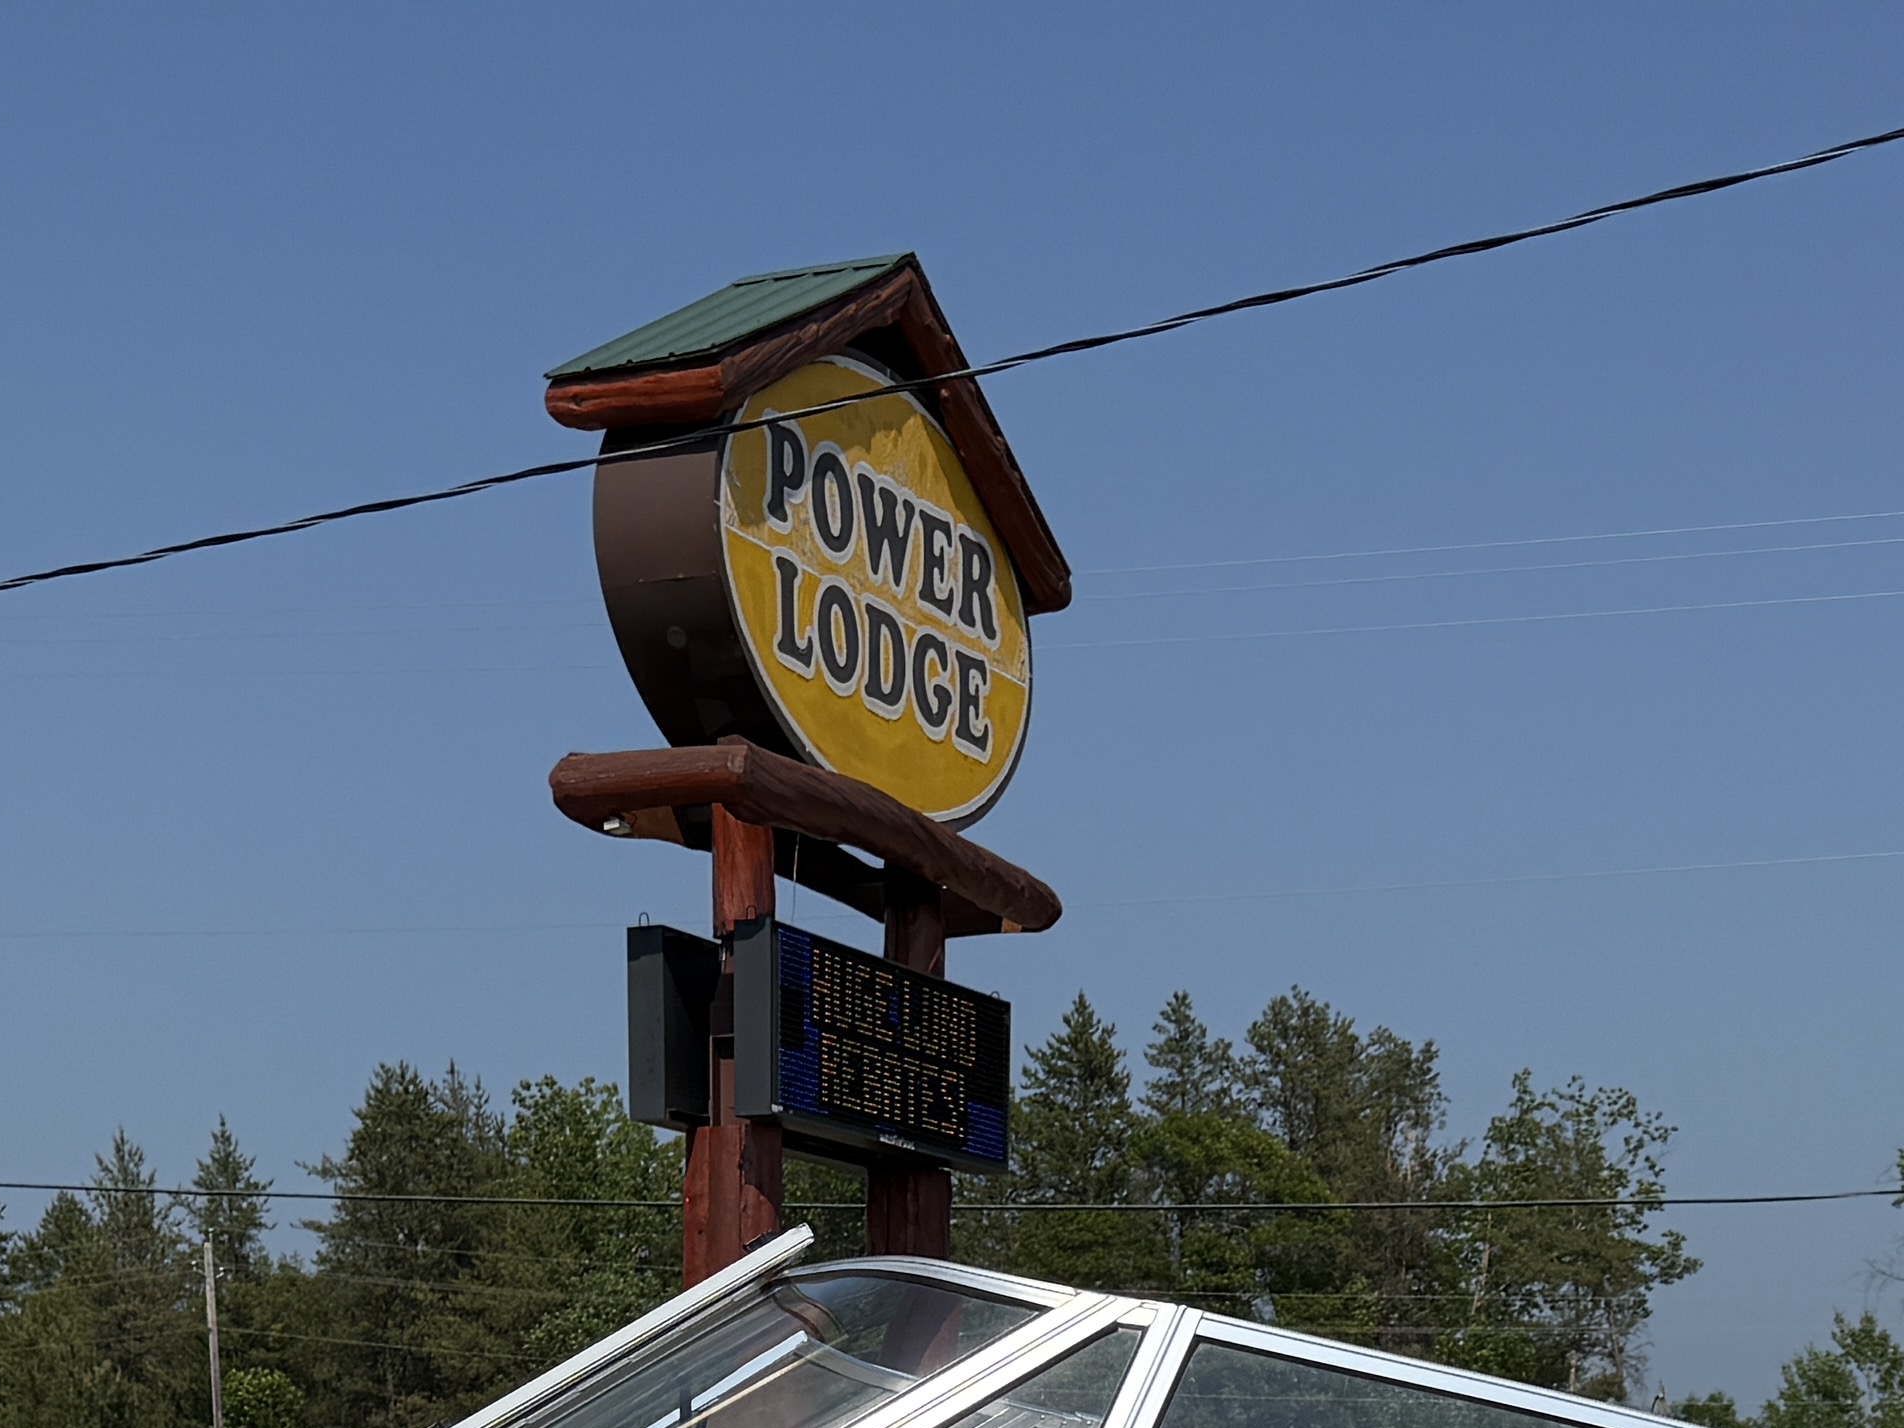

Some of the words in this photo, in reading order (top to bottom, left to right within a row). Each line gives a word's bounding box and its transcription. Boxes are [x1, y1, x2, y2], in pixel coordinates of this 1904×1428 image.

[765, 421, 998, 642] POWER
[775, 555, 990, 752] LODGE
[812, 948, 894, 1043] HUGE
